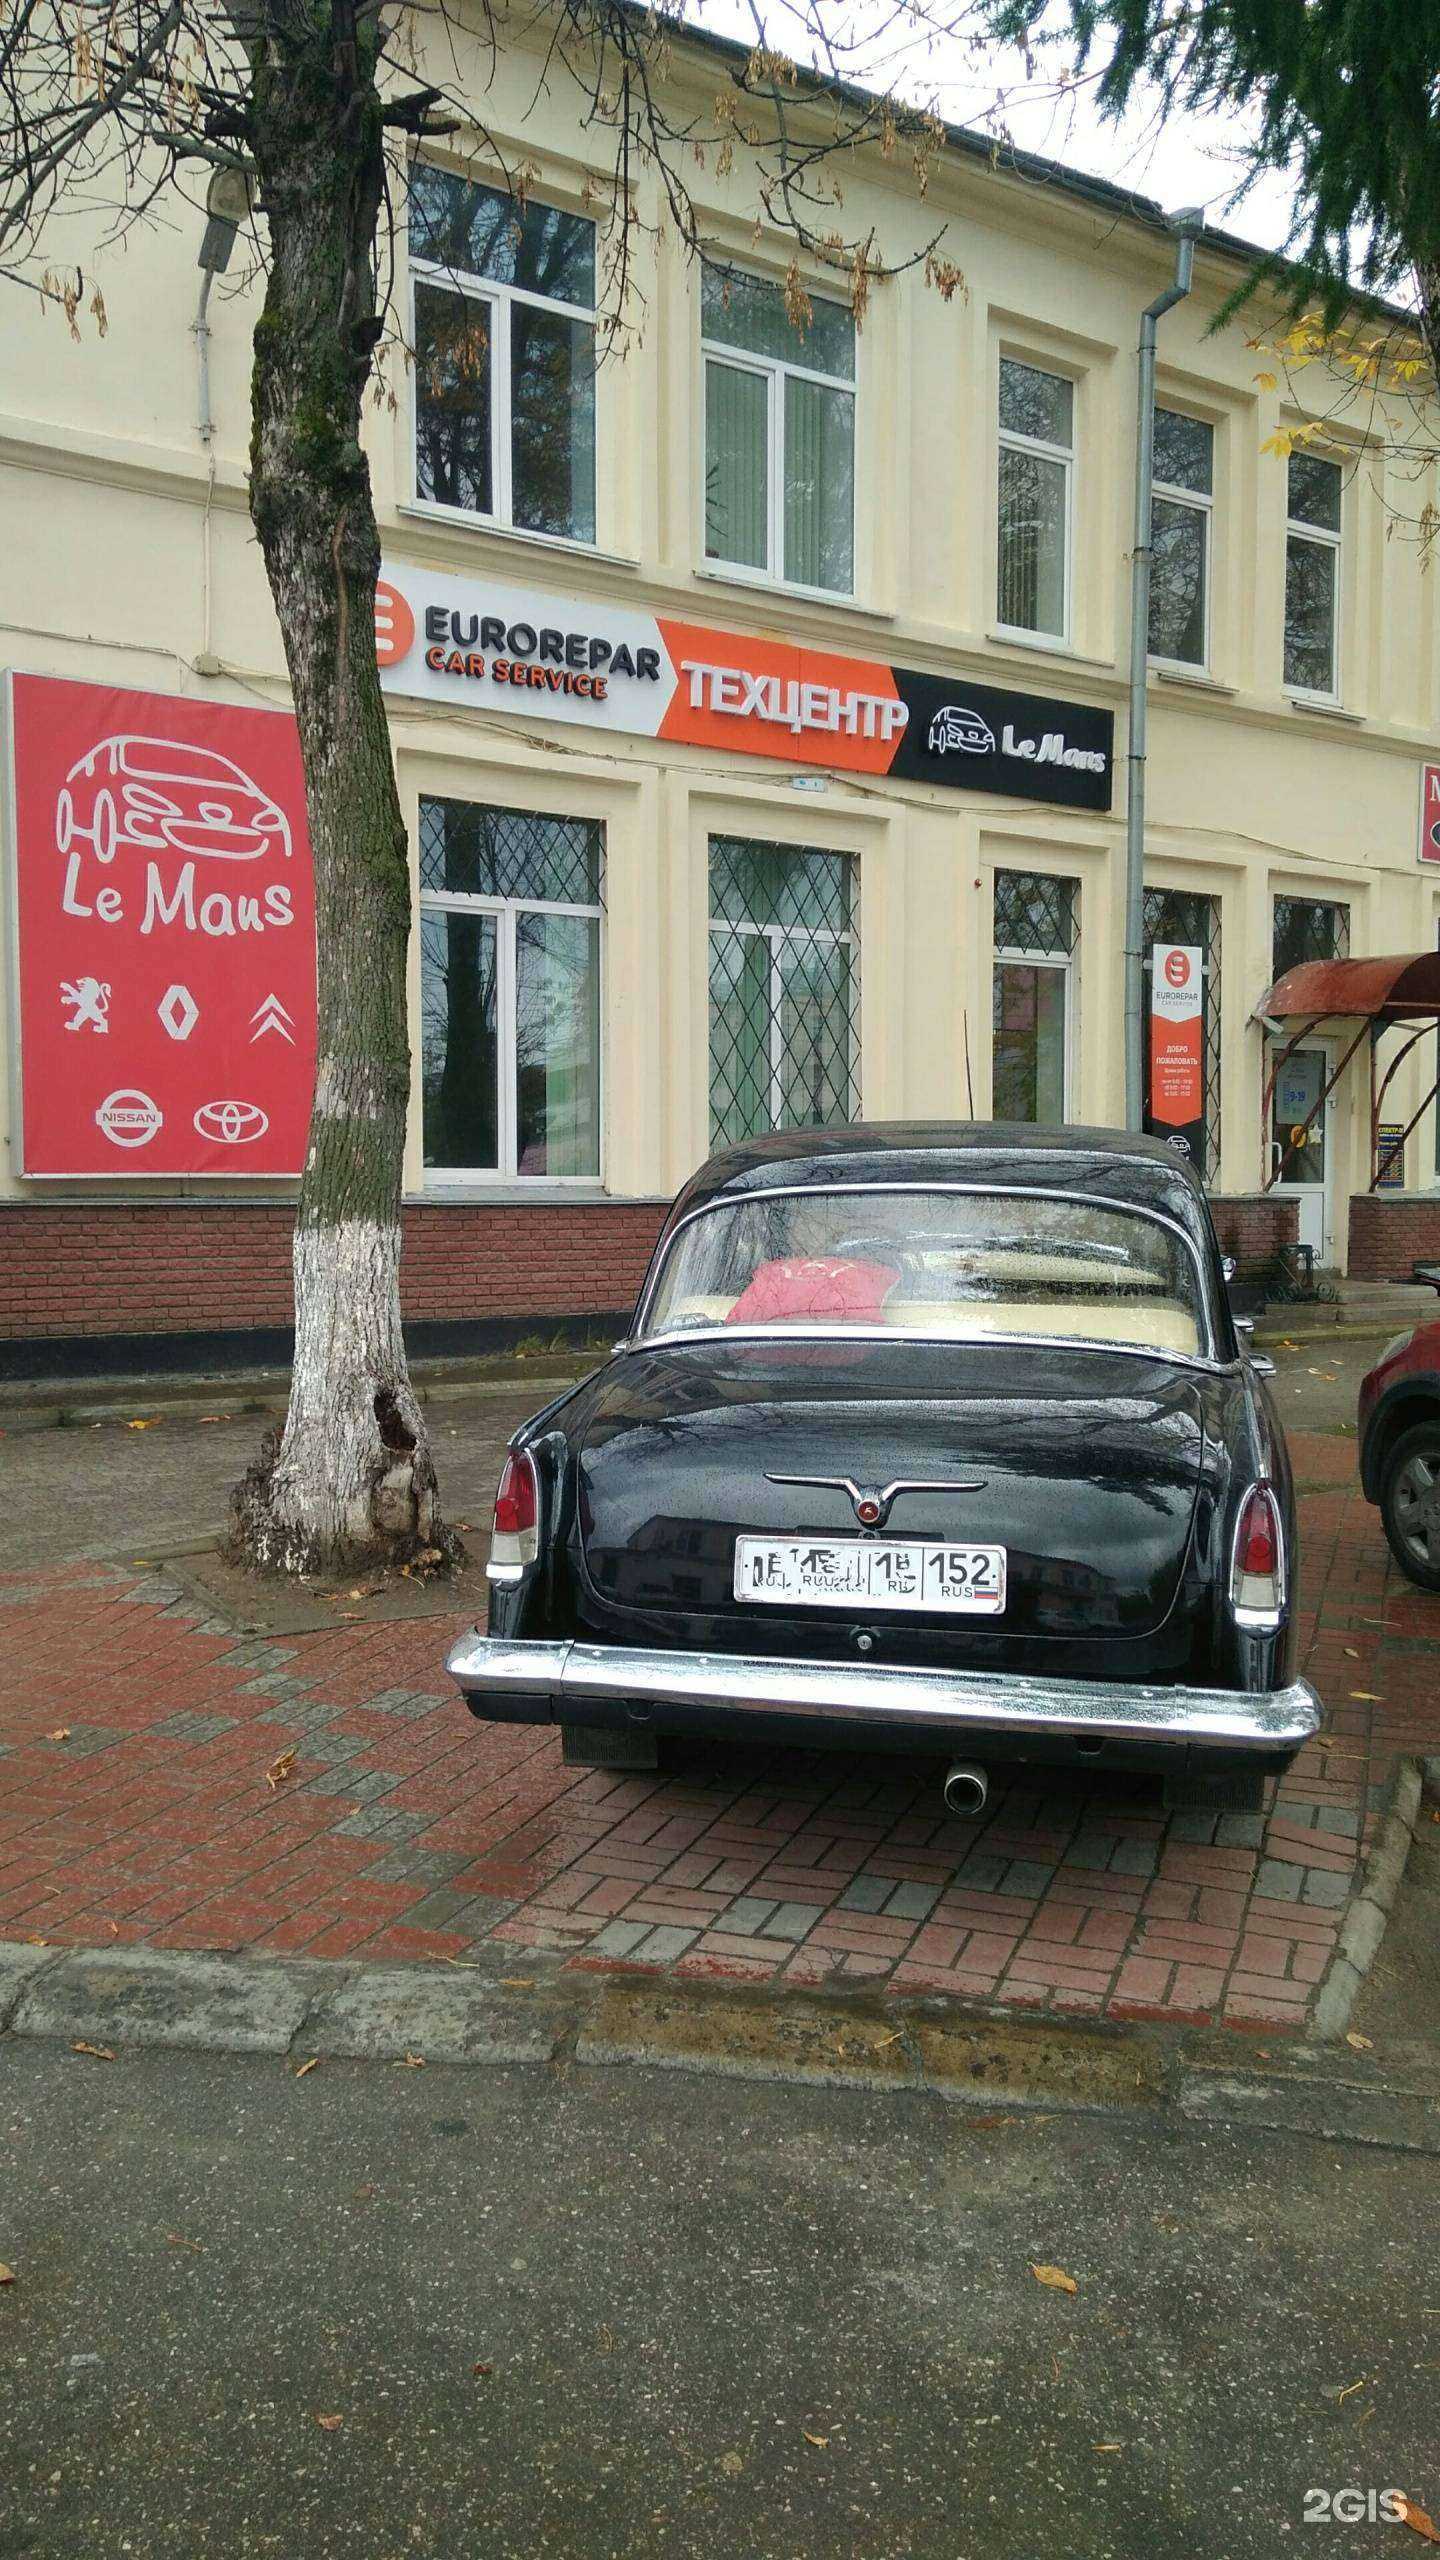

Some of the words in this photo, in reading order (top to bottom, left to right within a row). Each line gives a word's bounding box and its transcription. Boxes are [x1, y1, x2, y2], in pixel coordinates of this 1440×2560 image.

[425, 605, 661, 682] EUROREPAR
[425, 646, 485, 679] CAR
[491, 658, 609, 701] SERVICE
[680, 660, 910, 741] ТЕХЦЕНТР
[63, 852, 124, 923] Le
[140, 861, 295, 936] Mans
[1156, 991, 1199, 1001] EUROREPAR
[1156, 1056, 1198, 1065] ПОЖАЛОВАТЬ
[1166, 1045, 1189, 1054] ДОБРО
[102, 1112, 156, 1123] NISSAN
[928, 1552, 990, 1585] 152
[941, 1585, 973, 1598] RUS
